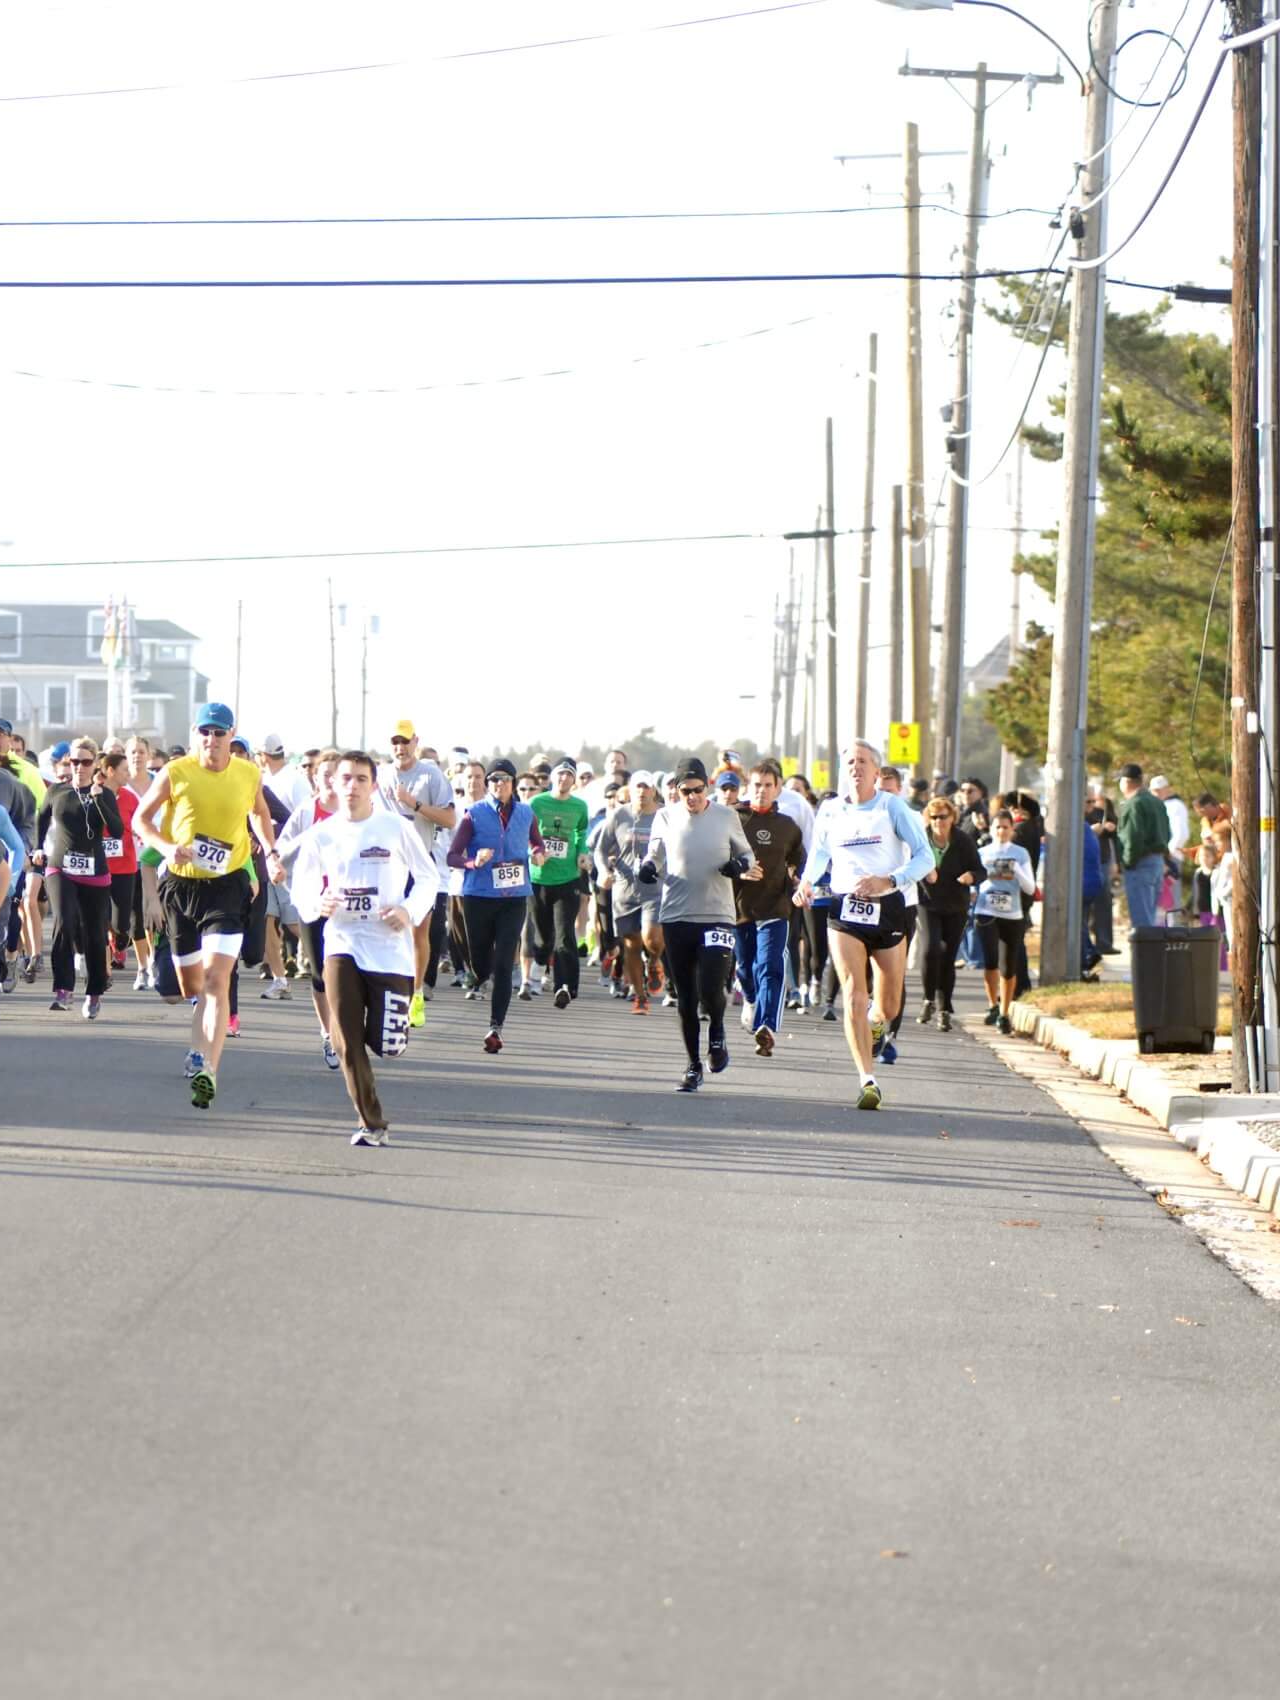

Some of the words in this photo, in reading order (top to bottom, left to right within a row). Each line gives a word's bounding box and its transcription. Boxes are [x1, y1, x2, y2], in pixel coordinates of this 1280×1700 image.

[197, 844, 226, 863] 970
[70, 857, 89, 869] 951
[498, 867, 520, 880] 856
[344, 896, 372, 911] 778
[849, 901, 875, 915] 750
